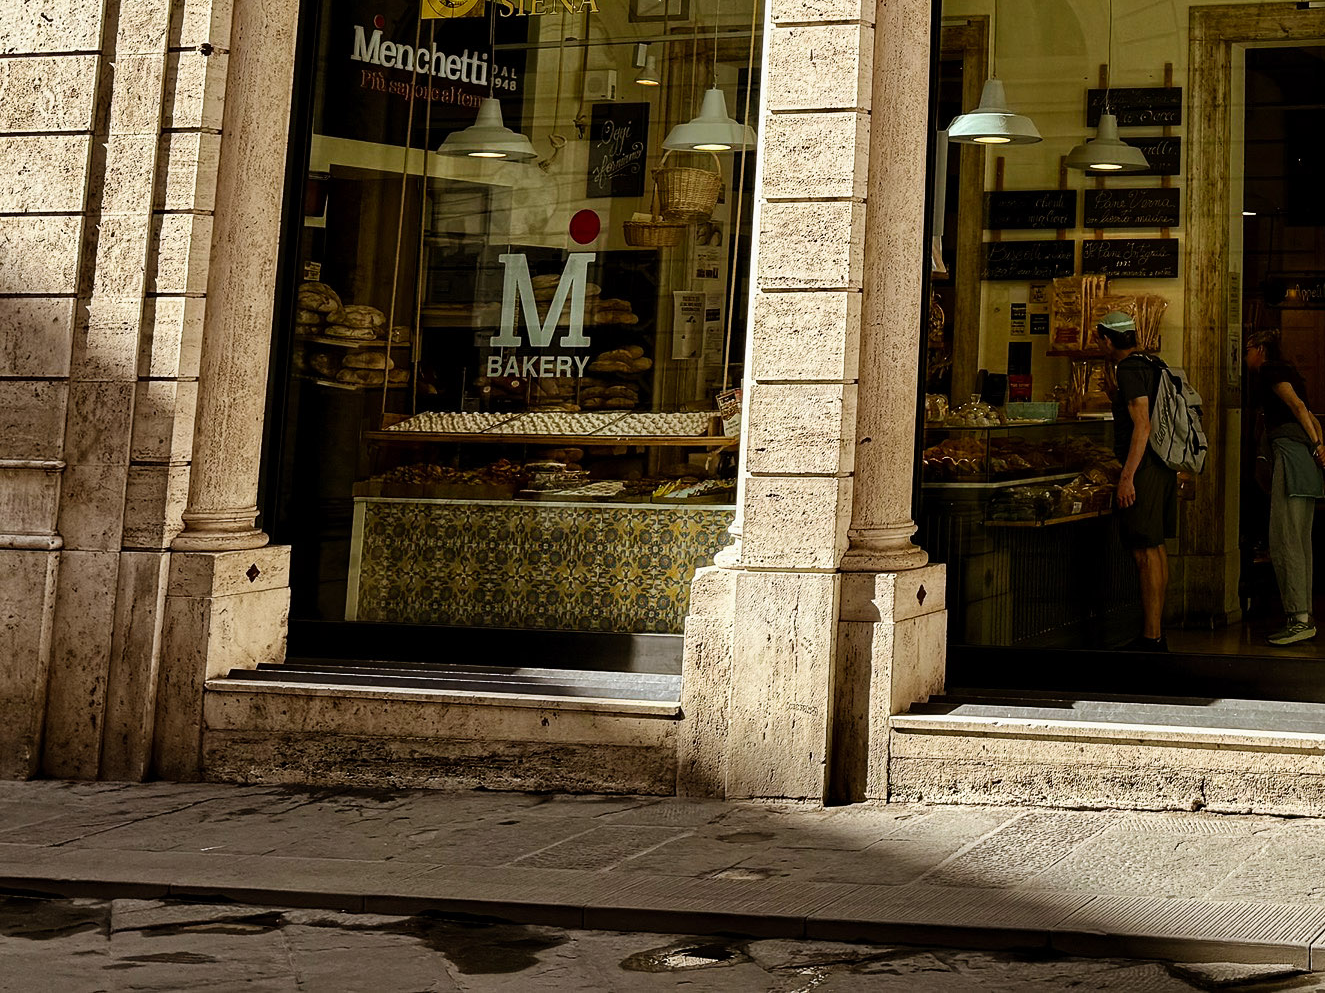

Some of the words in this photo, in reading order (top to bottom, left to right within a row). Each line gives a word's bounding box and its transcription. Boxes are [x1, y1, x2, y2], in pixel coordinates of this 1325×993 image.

[351, 25, 488, 86] Menchetti
[490, 77, 517, 91] 948
[597, 120, 632, 157] Oggi
[486, 356, 590, 379] BAKERY
